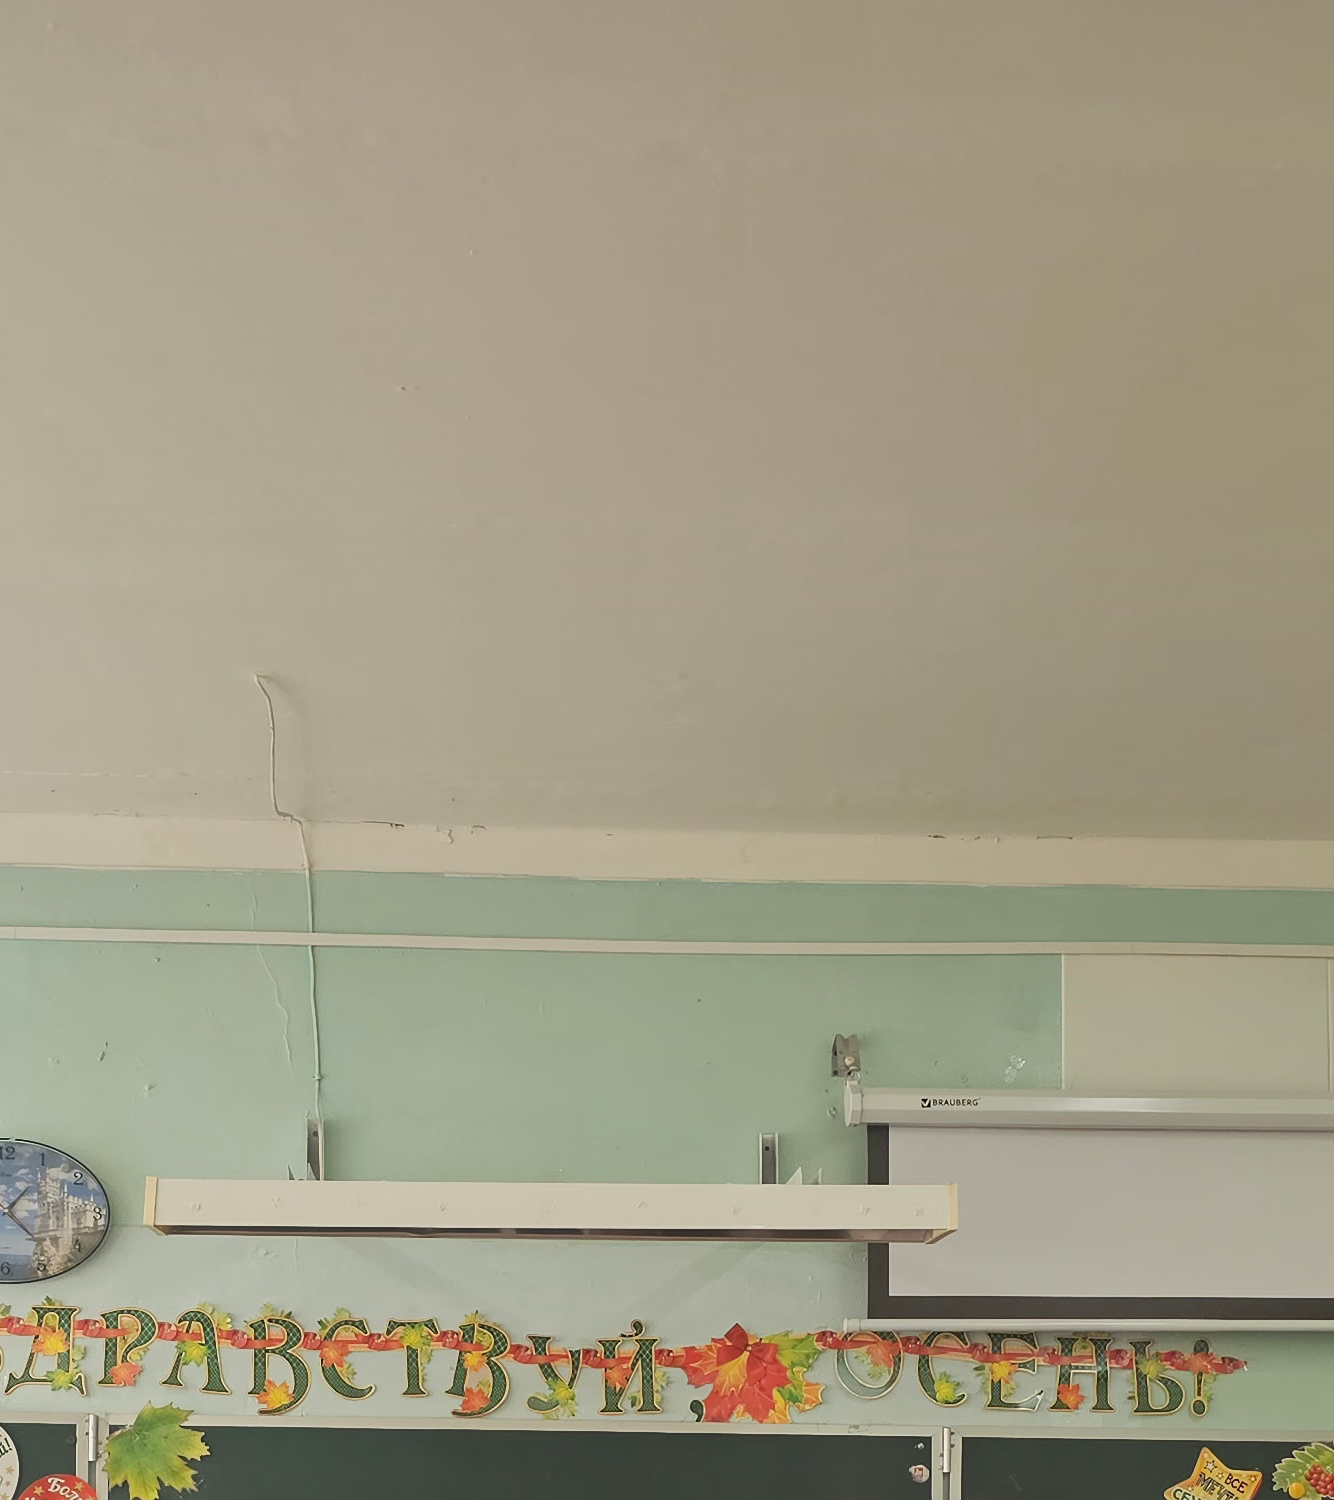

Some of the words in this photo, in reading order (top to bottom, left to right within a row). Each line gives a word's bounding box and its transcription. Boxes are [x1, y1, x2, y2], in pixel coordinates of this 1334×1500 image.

[931, 1098, 979, 1107] BRAUBERG
[38, 1152, 47, 1166] 1
[73, 1171, 84, 1186] 2
[92, 1207, 103, 1221] 3
[72, 1238, 82, 1253] 4
[0, 1261, 11, 1276] 6
[37, 1258, 47, 1272] 5
[833, 1330, 1212, 1416] ОСЕНЬ!
[1224, 1472, 1249, 1494] ВСЕ
